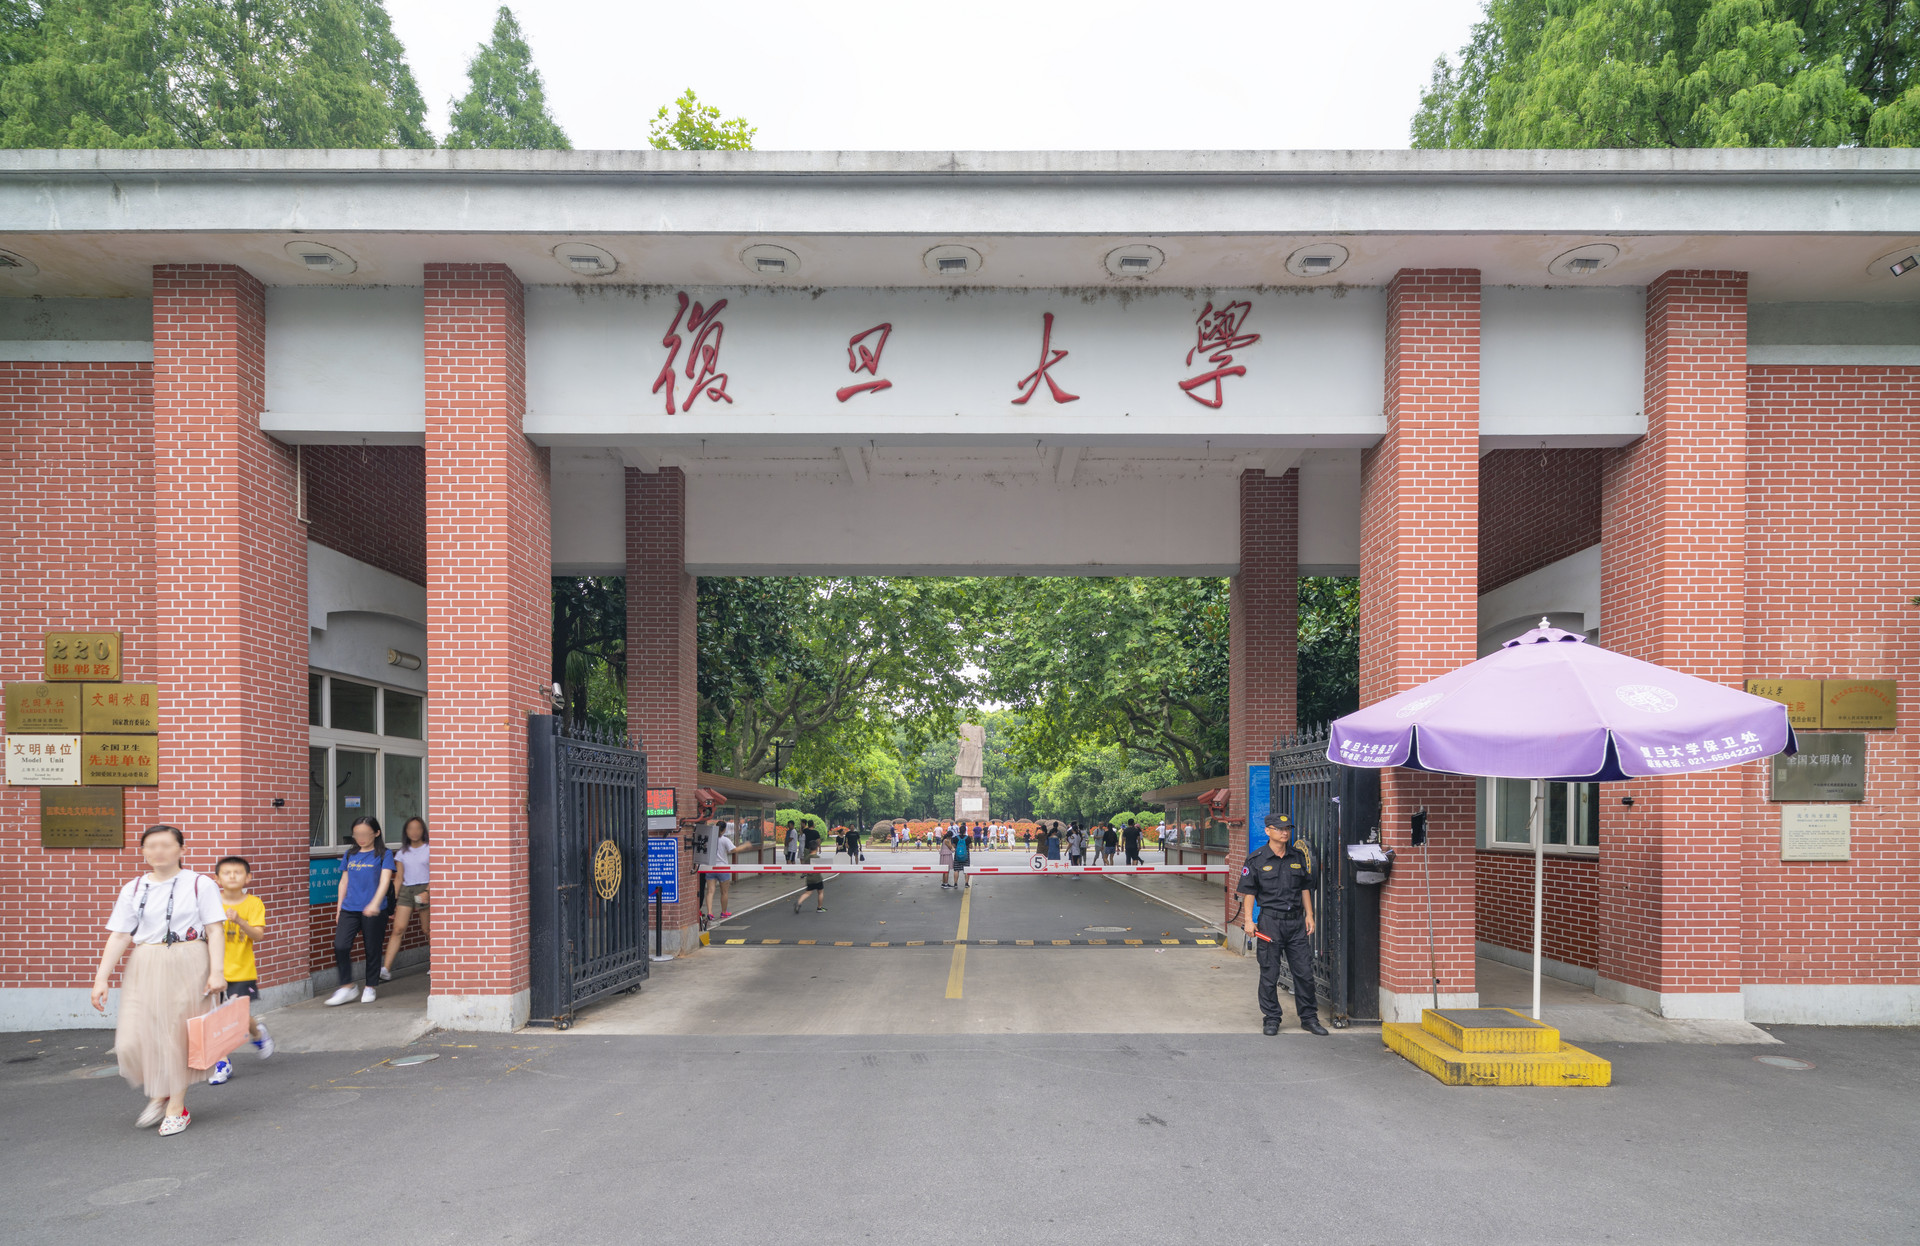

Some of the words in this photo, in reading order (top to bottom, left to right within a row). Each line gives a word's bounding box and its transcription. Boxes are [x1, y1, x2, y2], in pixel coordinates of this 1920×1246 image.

[52, 638, 111, 660] 220
[53, 664, 110, 675] 邯郸路
[13, 743, 72, 755] 文明单位
[1640, 731, 1760, 758] 复旦大学保卫处
[88, 754, 152, 767] 先进单位
[1786, 754, 1852, 765] 全国文明单位
[1034, 856, 1043, 869] 5
